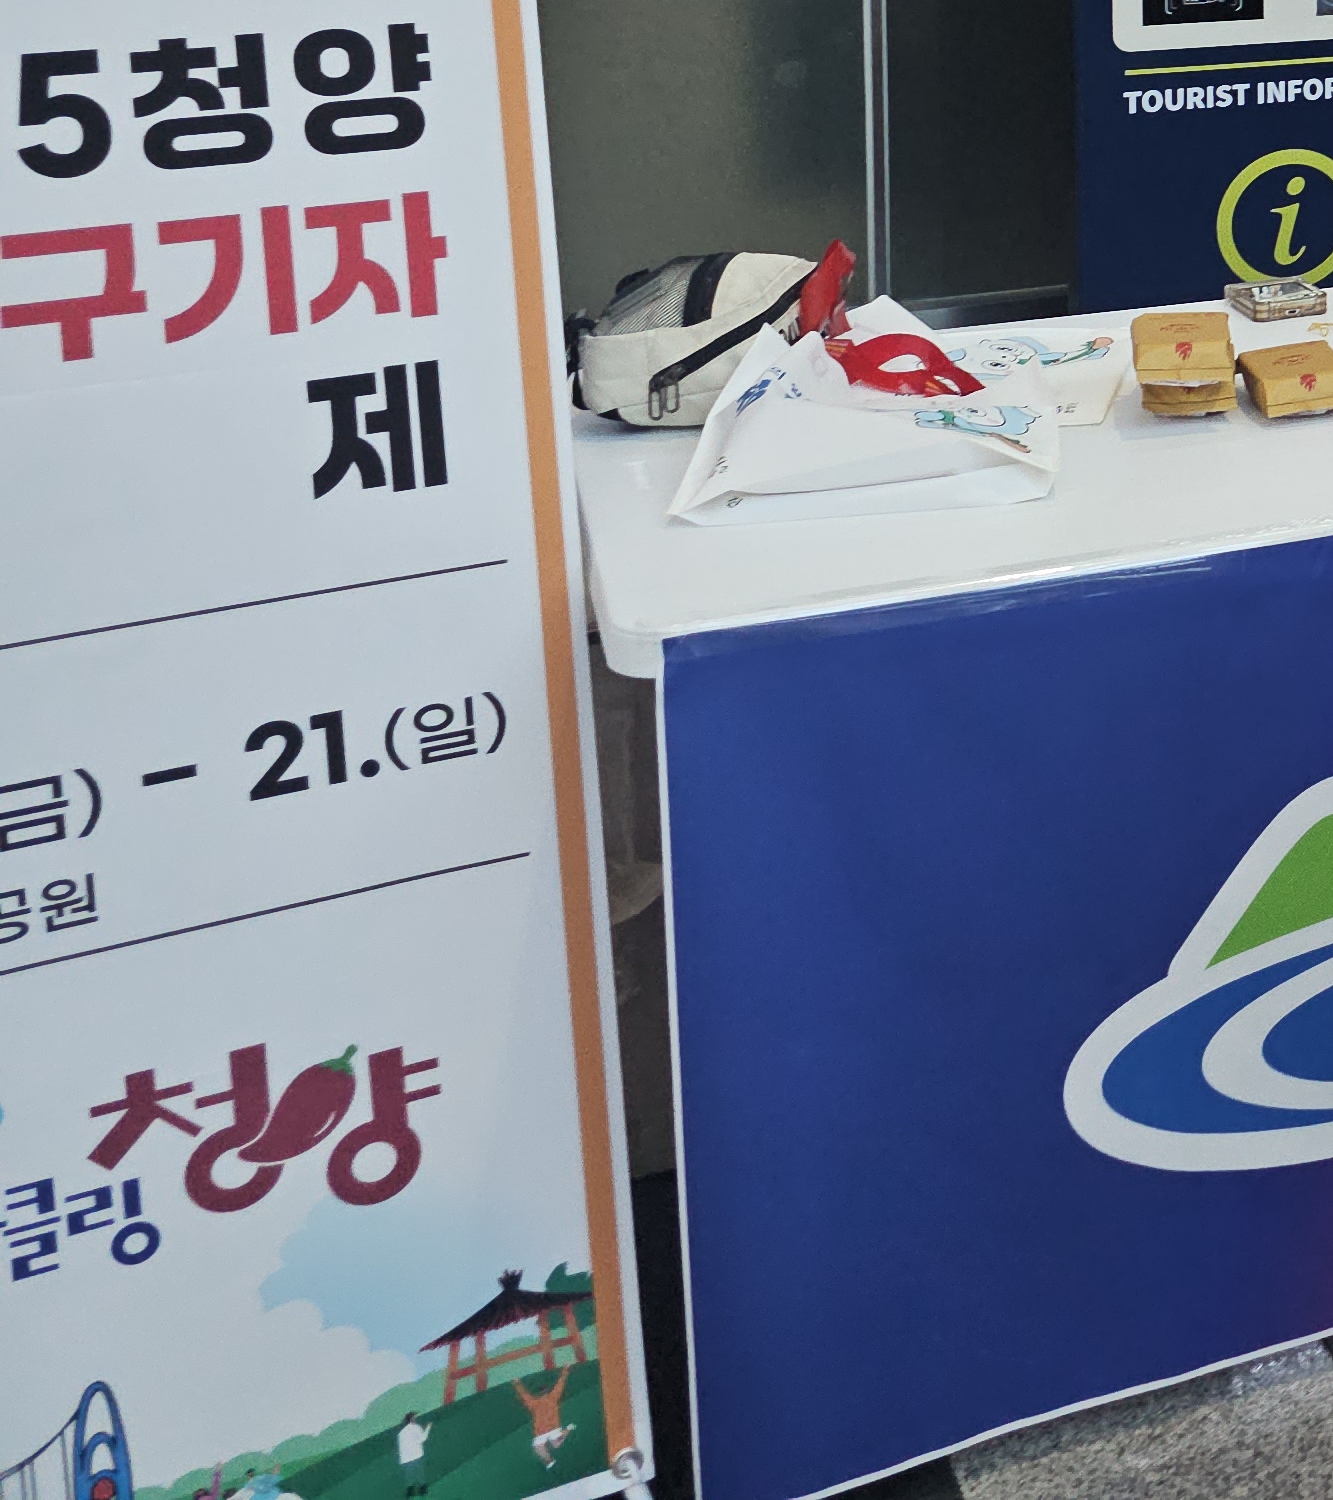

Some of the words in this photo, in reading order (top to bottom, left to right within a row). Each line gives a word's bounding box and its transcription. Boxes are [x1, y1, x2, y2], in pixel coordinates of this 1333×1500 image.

[1122, 82, 1251, 115] TOURIST
[0, 190, 449, 363] 구기자
[306, 359, 449, 501] 제
[243, 690, 507, 802] 21.(일)
[87, 1042, 442, 1213] 청양
[0, 1176, 161, 1283] 클링
